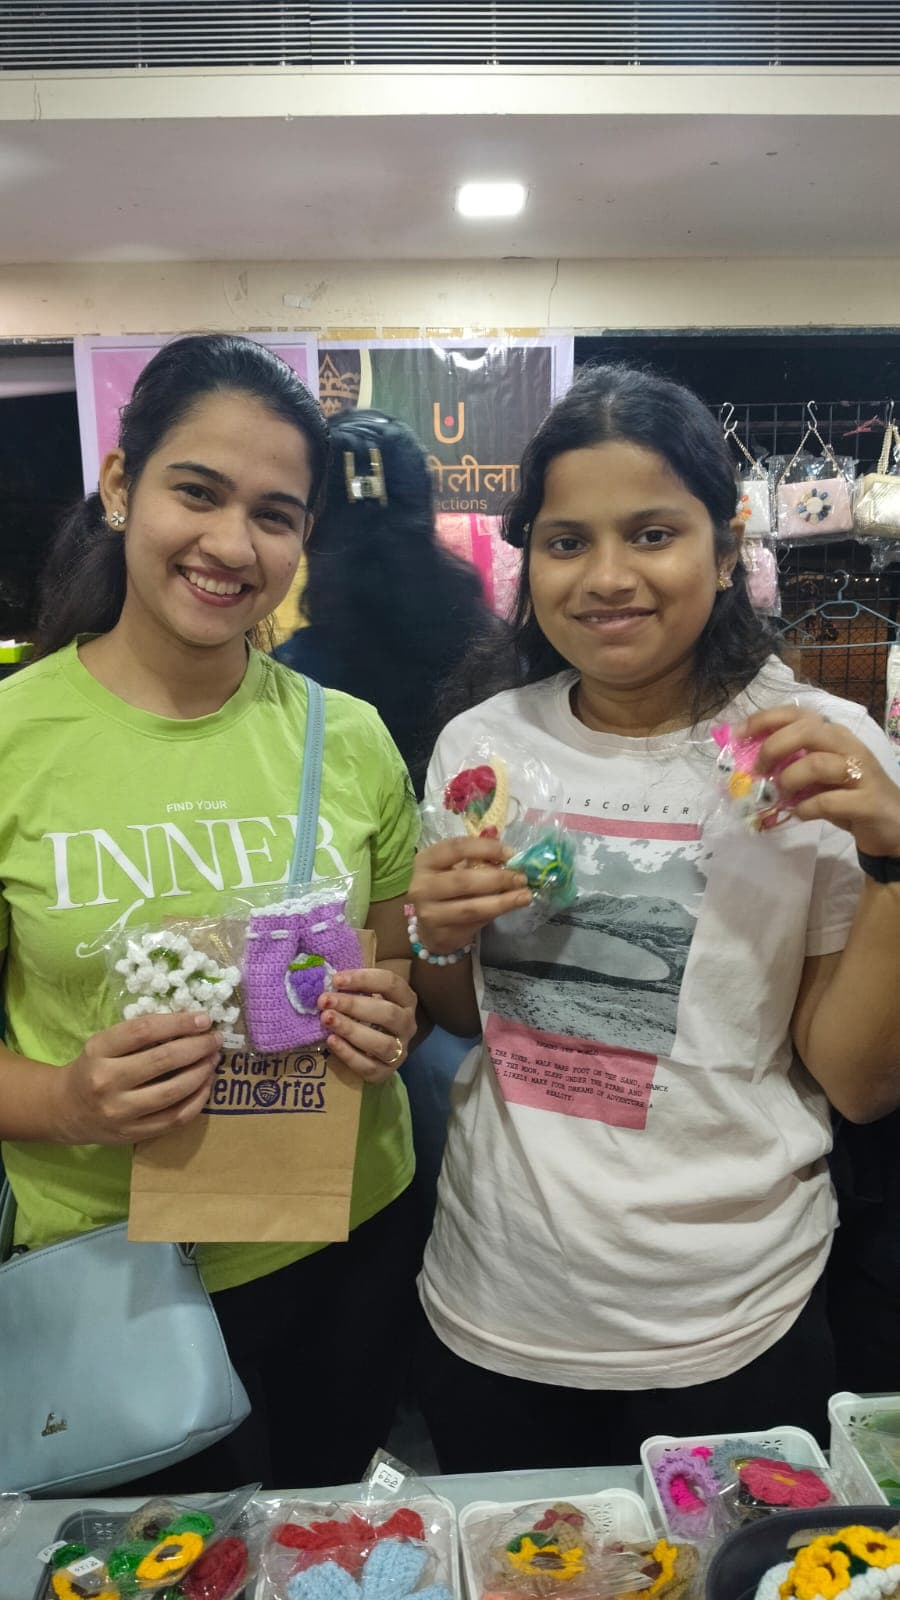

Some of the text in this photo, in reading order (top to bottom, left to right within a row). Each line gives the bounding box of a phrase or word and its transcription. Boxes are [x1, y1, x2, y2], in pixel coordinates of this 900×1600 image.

[166, 799, 228, 813] FIND YOUR
[549, 795, 690, 815] DISCOVER
[42, 814, 352, 911] INNER
[531, 1077, 548, 1086] MAKE
[573, 1067, 590, 1075] FOOT
[620, 1077, 641, 1088] SAND,
[645, 1083, 669, 1092] DANCE
[206, 1077, 327, 1109] emories
[628, 1089, 642, 1097] AND
